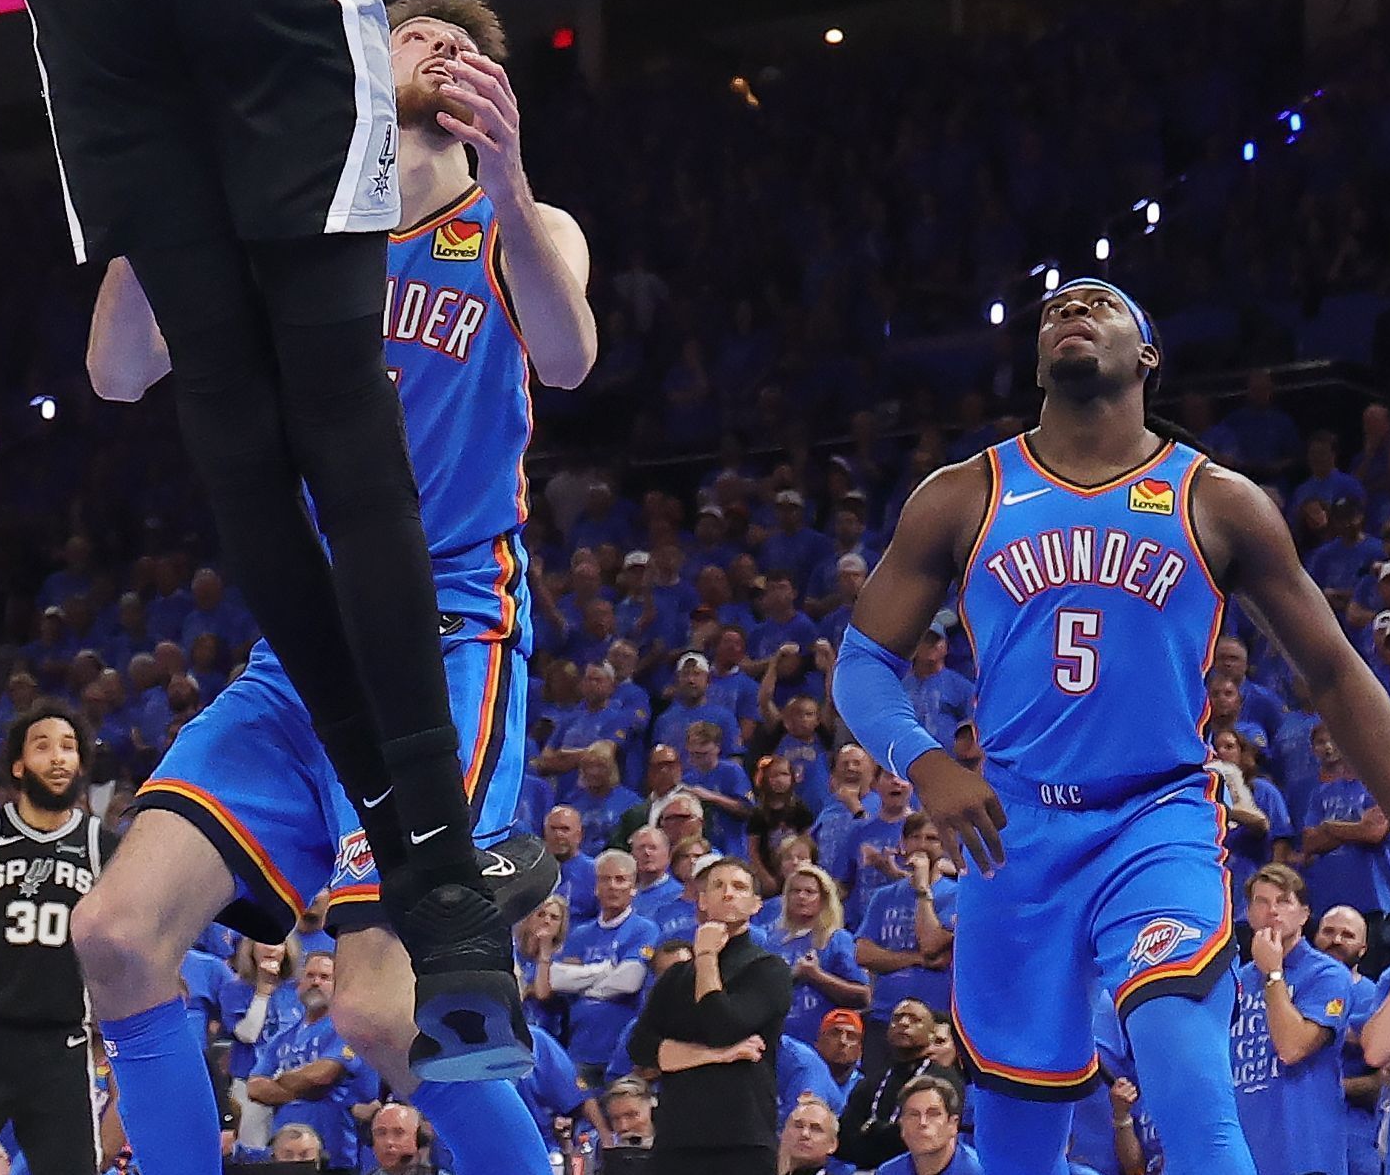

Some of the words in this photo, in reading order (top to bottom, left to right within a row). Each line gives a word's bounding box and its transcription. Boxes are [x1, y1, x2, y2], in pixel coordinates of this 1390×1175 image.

[987, 528, 1187, 611] THUNDER
[1054, 608, 1101, 695] 5
[1040, 783, 1082, 805] OKC
[4, 899, 71, 947] 30
